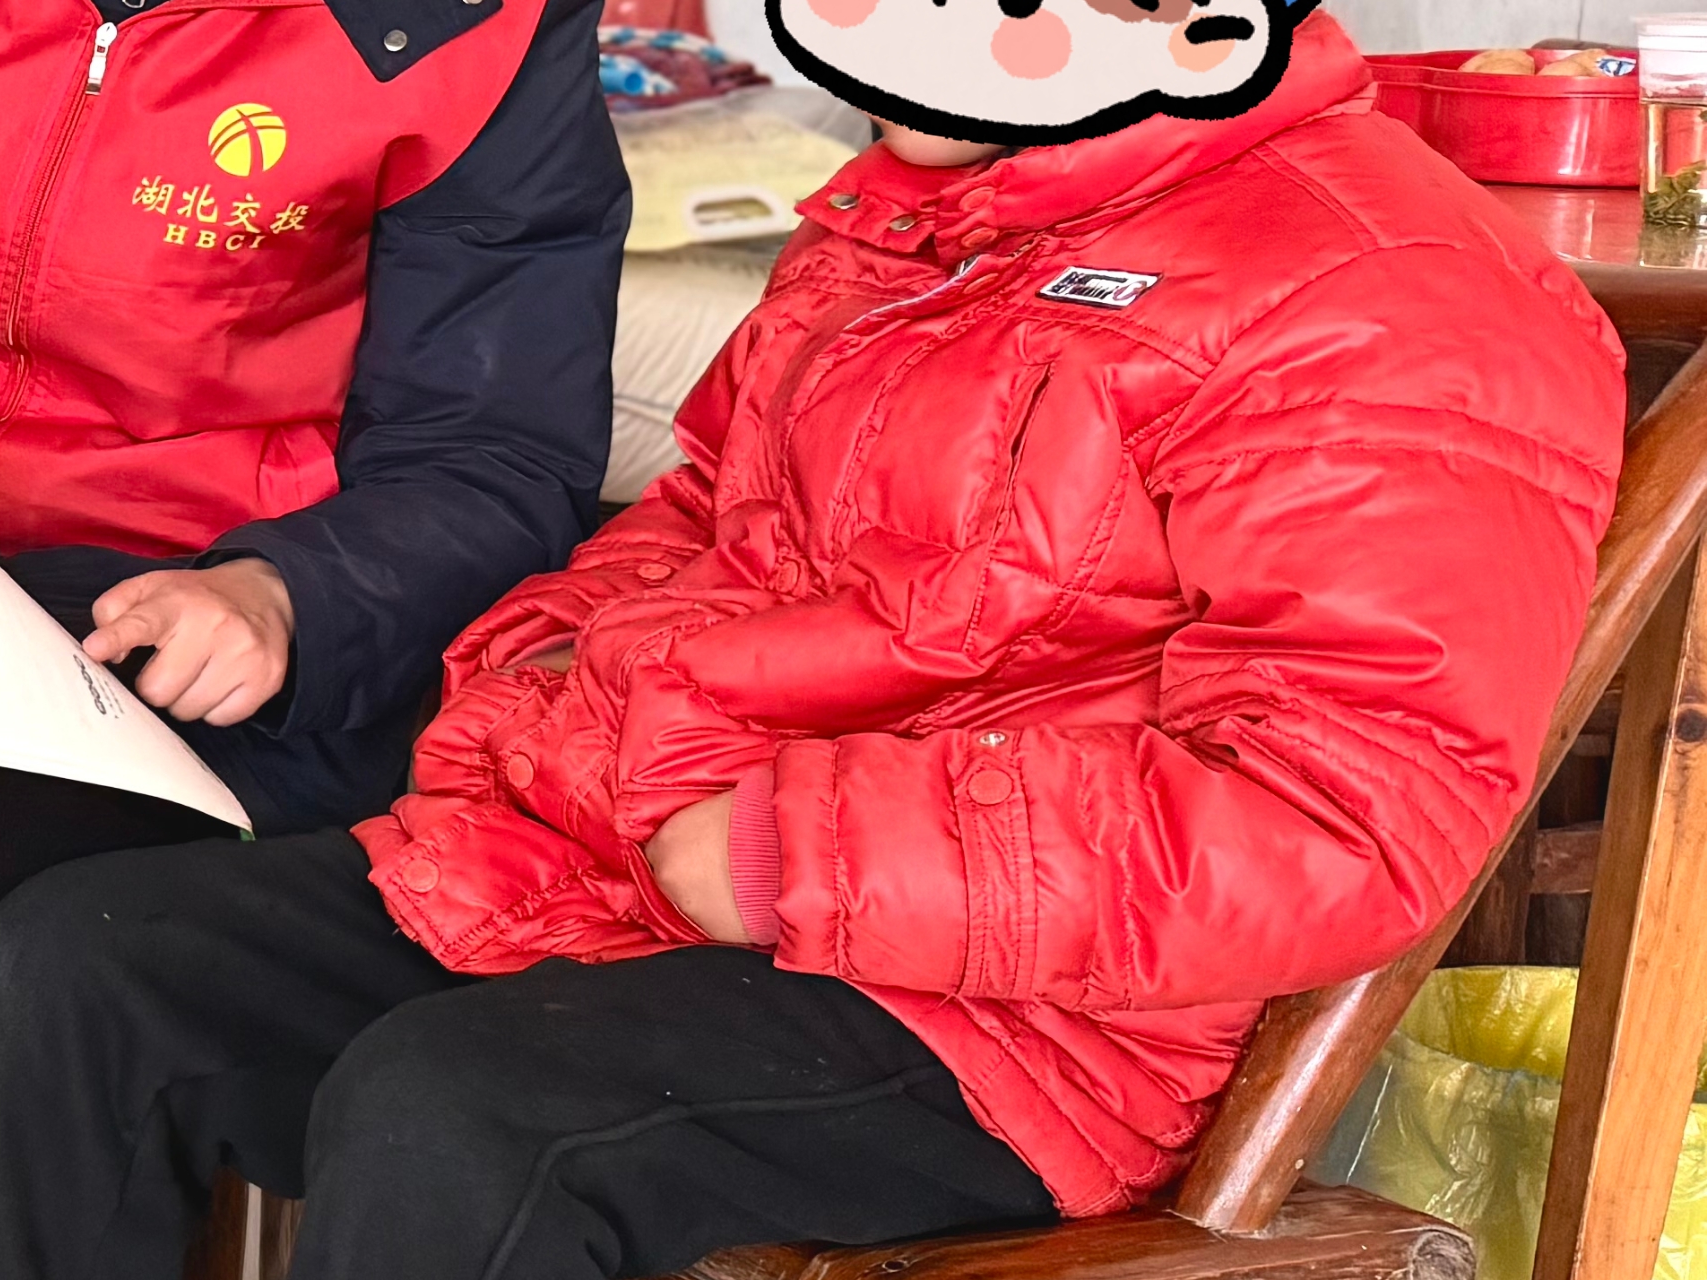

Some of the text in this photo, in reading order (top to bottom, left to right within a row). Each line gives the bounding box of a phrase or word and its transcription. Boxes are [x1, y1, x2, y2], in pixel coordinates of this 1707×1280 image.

[132, 175, 310, 235] 湖北交投
[163, 223, 266, 251] HBCI
